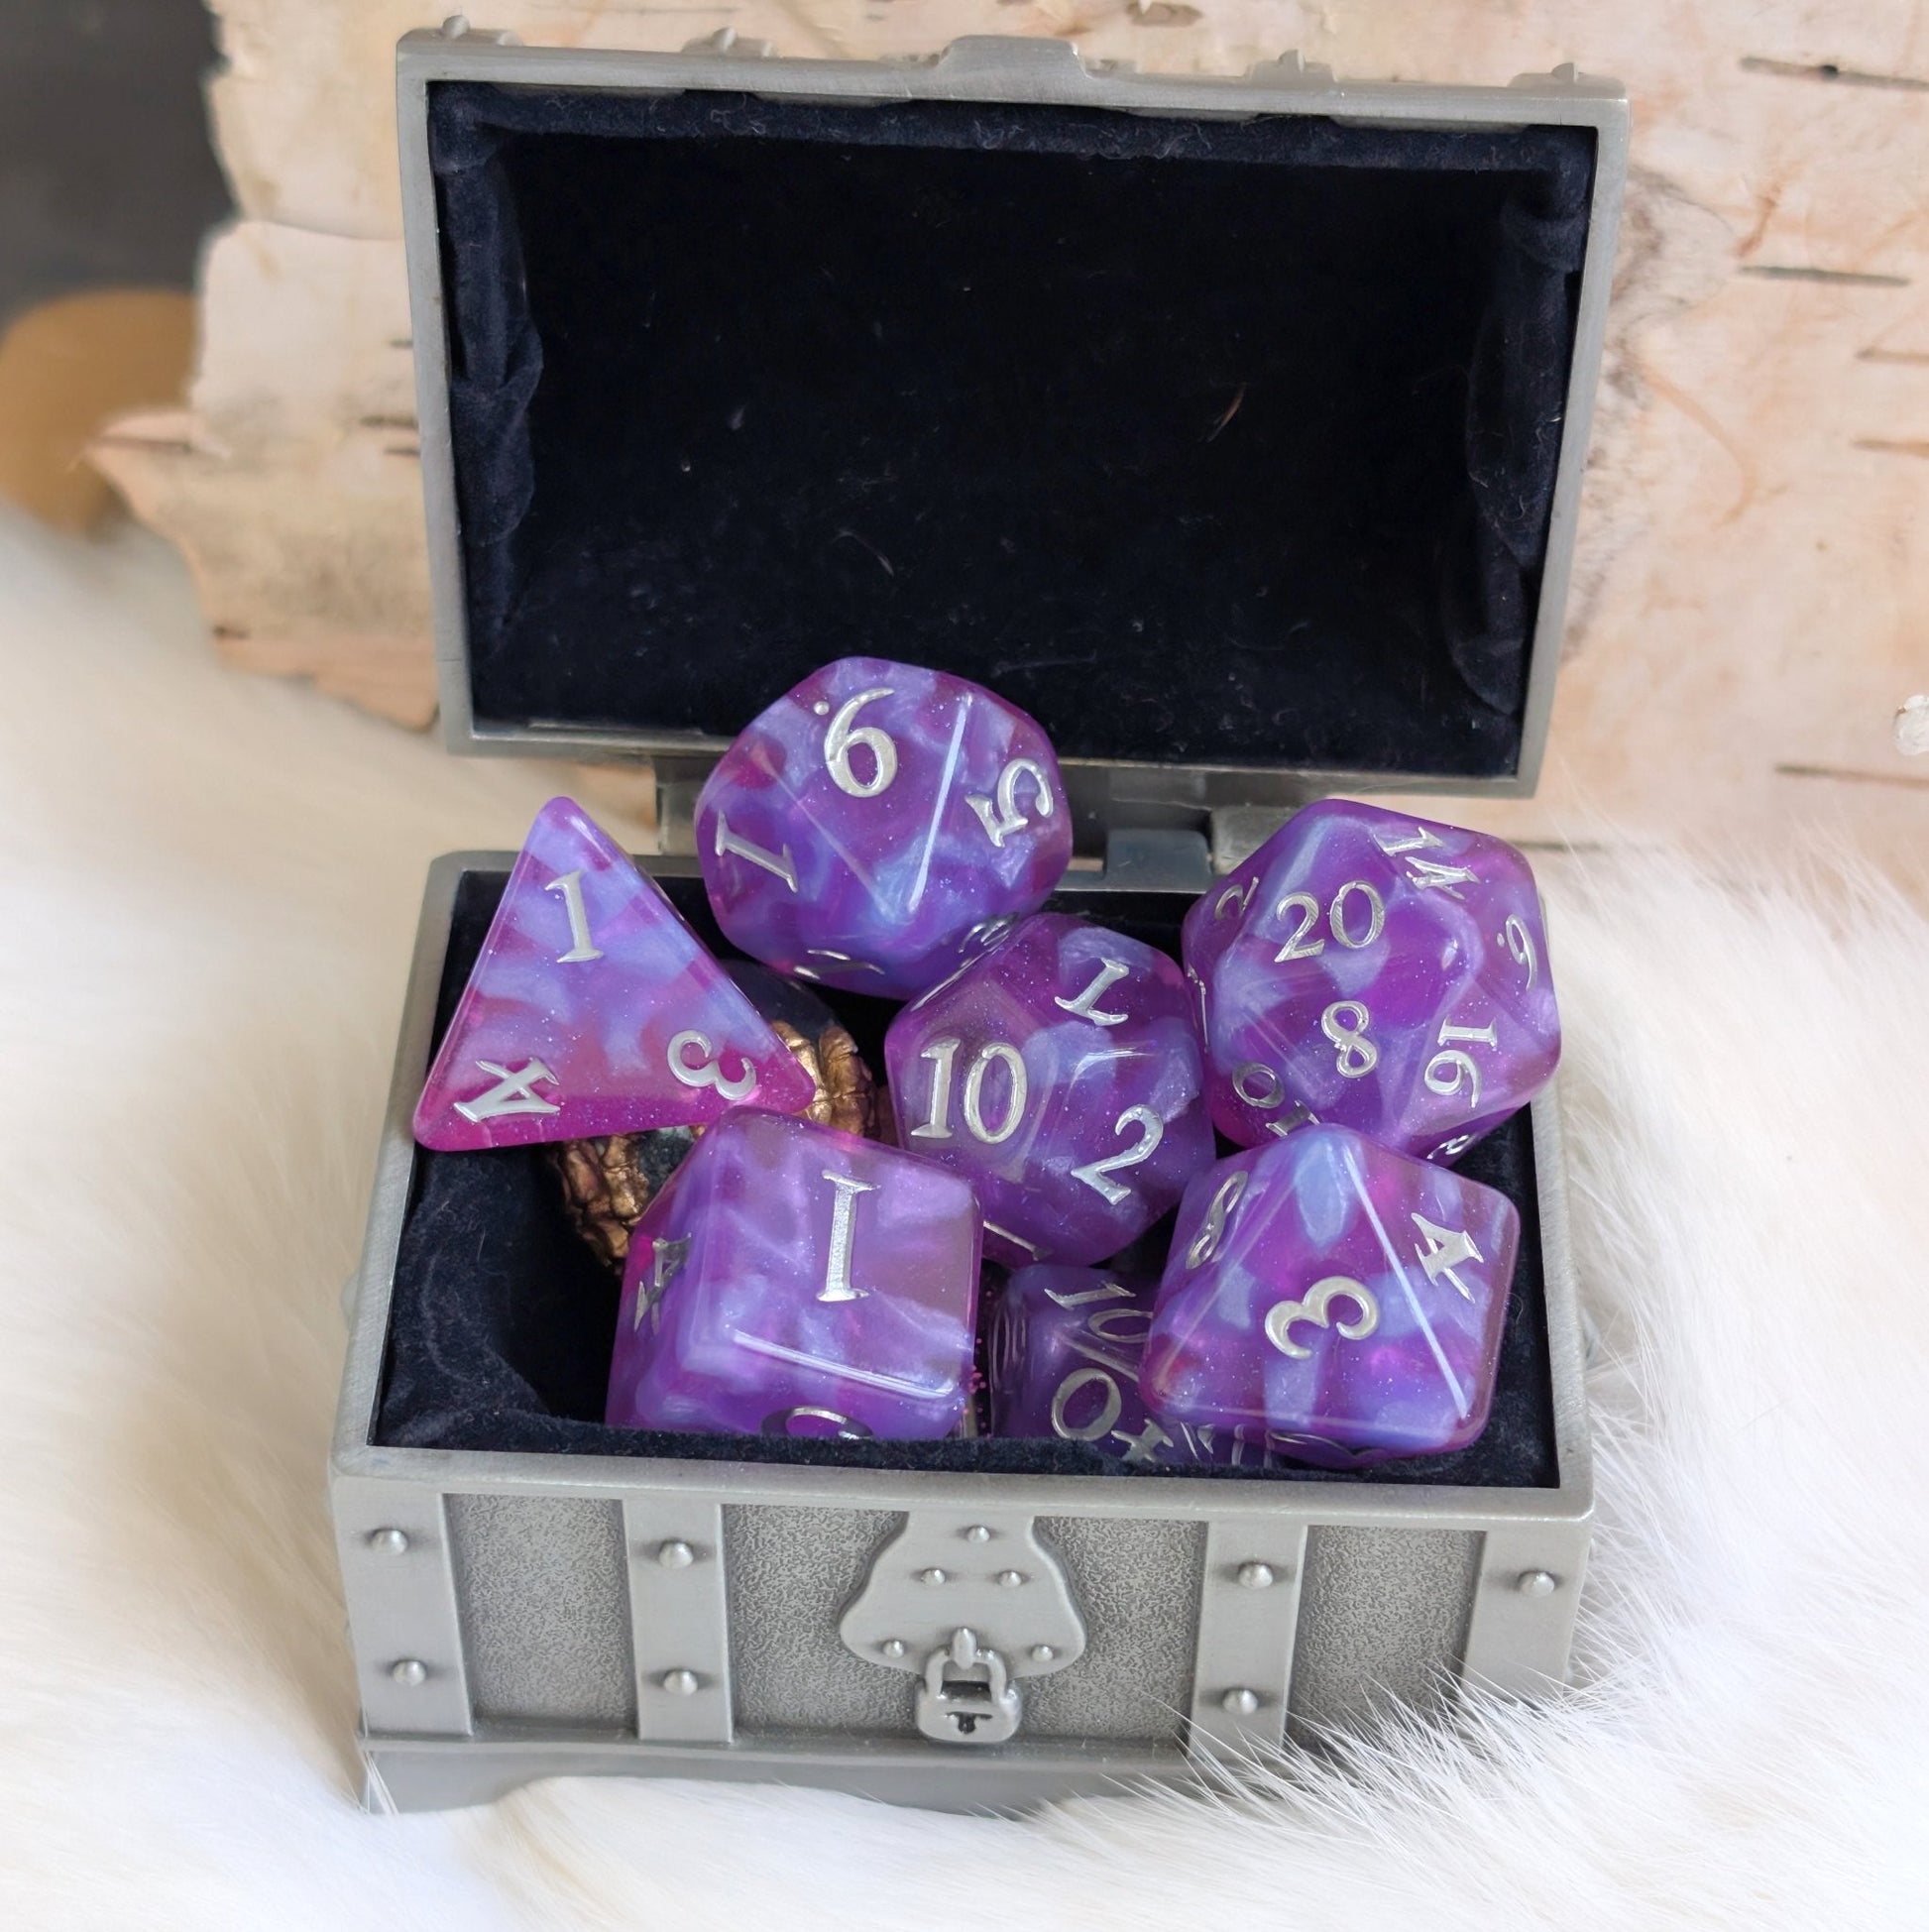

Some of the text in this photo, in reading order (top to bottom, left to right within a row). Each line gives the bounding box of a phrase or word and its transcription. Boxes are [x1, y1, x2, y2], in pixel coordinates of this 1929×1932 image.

[964, 757, 1055, 849] 5
[544, 869, 604, 965] 1
[1274, 880, 1386, 965] 20
[666, 1029, 757, 1101] 3
[1320, 999, 1379, 1079] 8
[453, 1057, 561, 1123] 4
[911, 1038, 1028, 1144] 10
[1071, 1104, 1165, 1205] 2
[816, 1170, 881, 1303] 1
[1411, 1211, 1485, 1304] 4
[1264, 1276, 1381, 1360] 3
